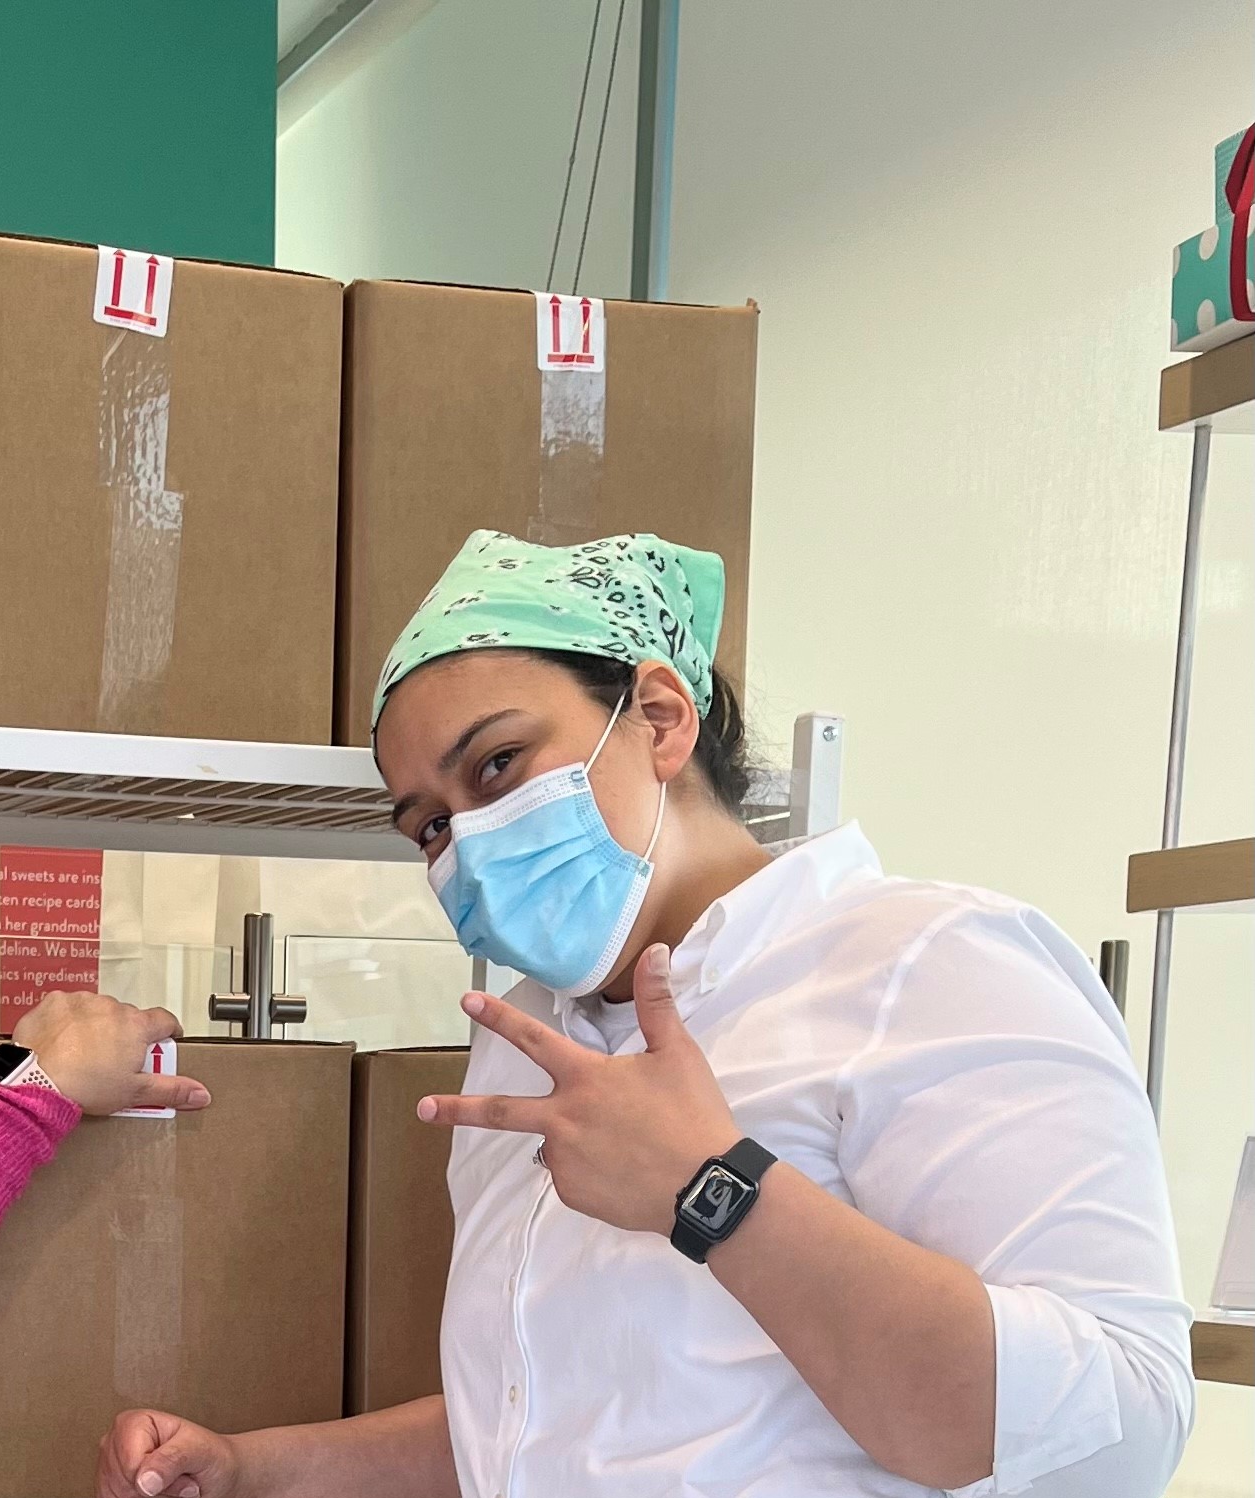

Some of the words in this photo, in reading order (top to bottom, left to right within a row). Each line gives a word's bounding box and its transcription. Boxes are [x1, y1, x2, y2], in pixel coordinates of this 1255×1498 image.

[11, 870, 55, 883] sweets
[58, 873, 79, 884] are
[22, 893, 63, 912] recipe
[66, 894, 100, 909] cards
[6, 915, 28, 931] her
[31, 917, 100, 936] grandmoth
[45, 941, 67, 957] We
[70, 942, 100, 958] bake
[23, 966, 99, 986] ingredients,
